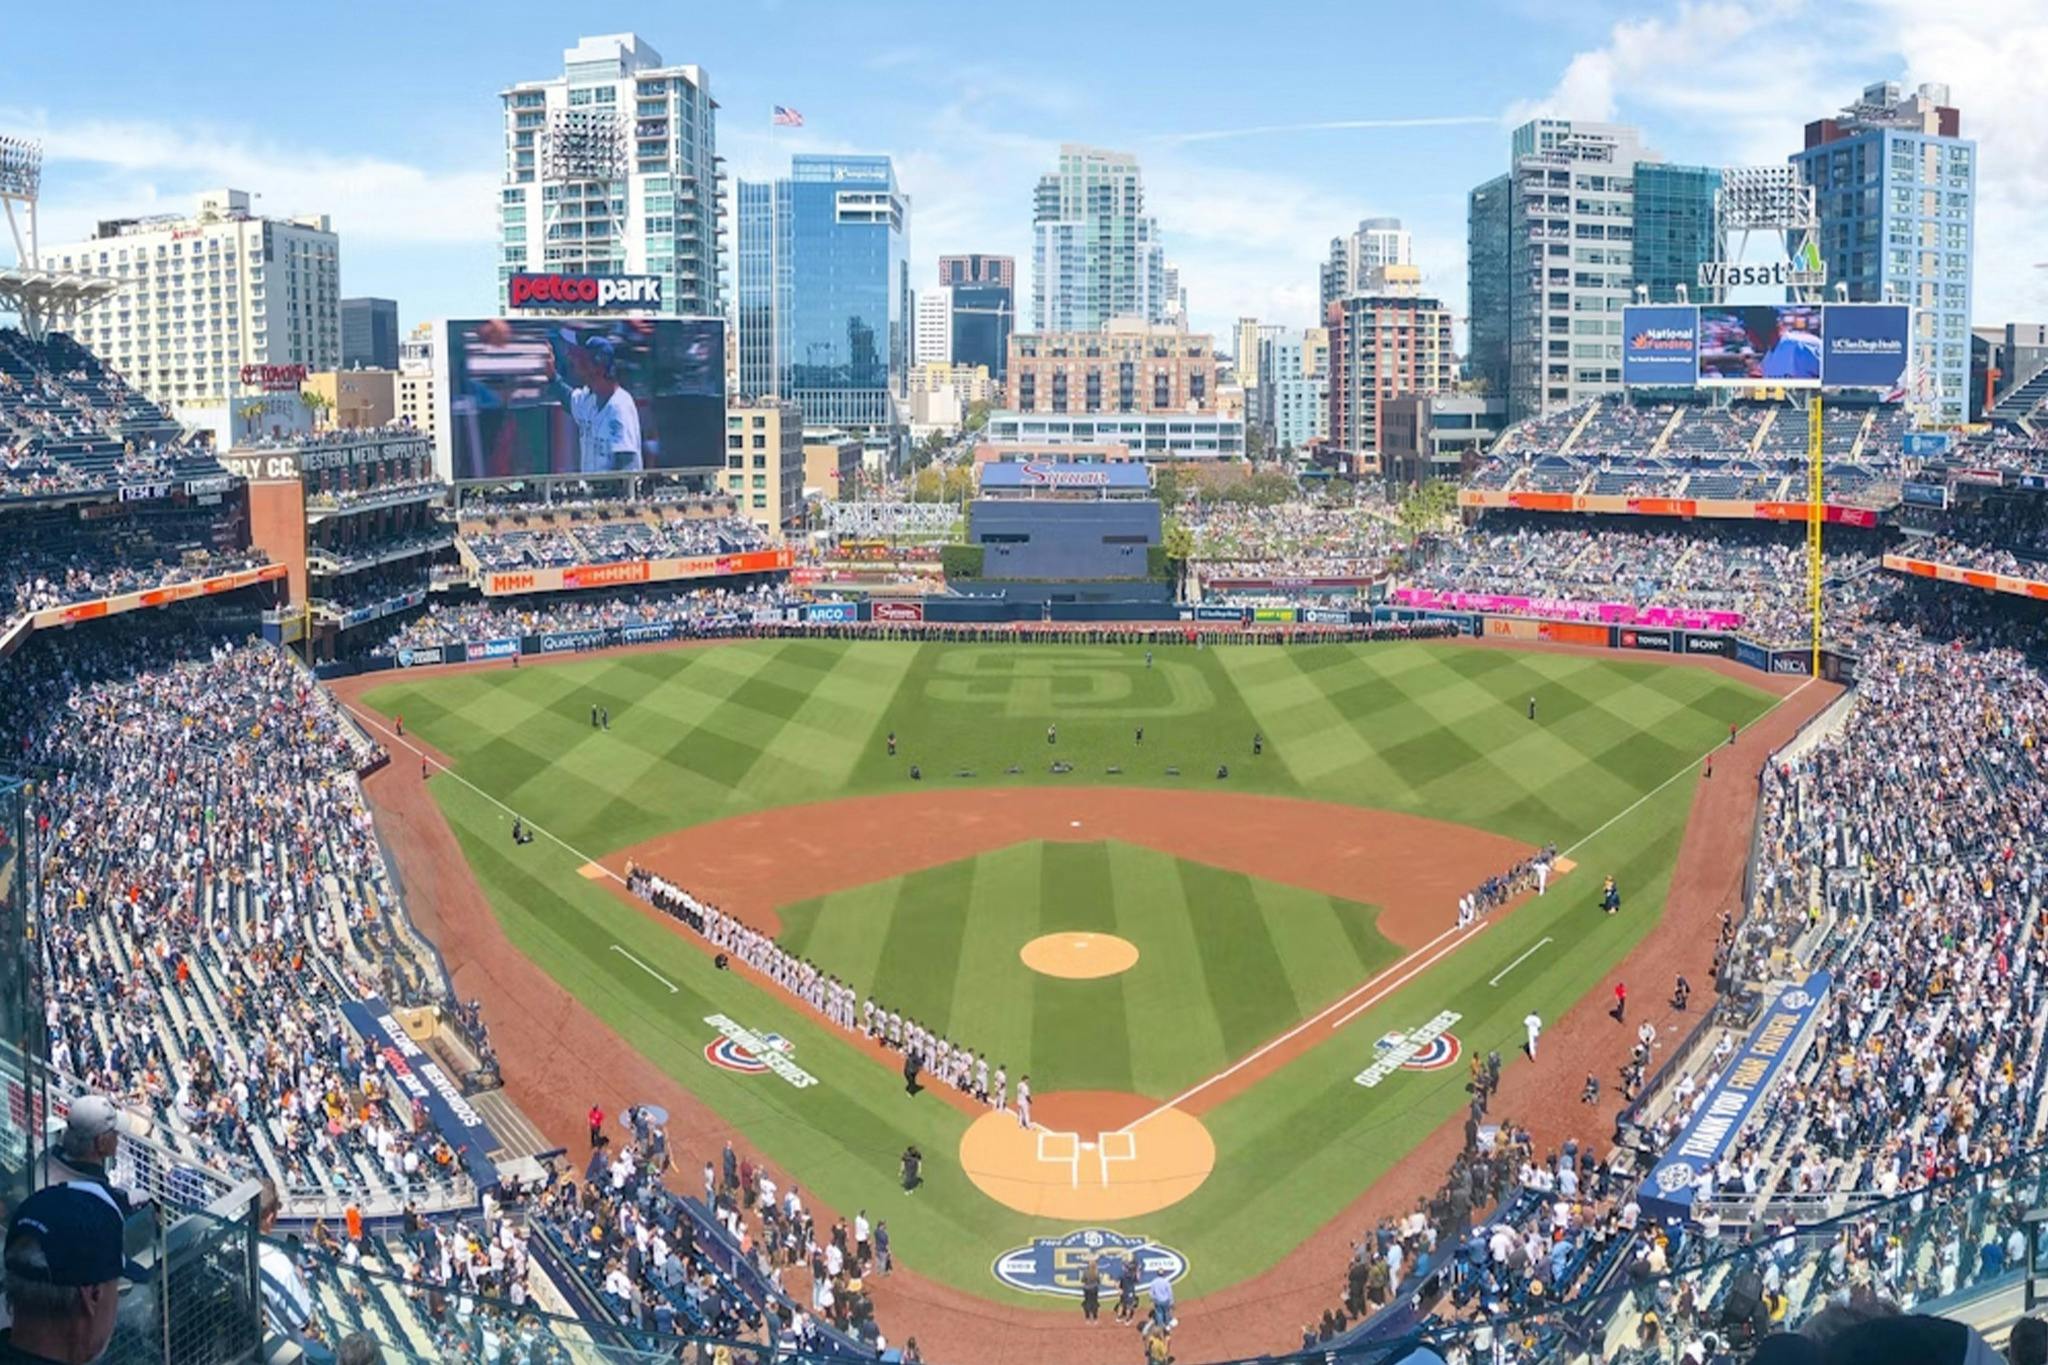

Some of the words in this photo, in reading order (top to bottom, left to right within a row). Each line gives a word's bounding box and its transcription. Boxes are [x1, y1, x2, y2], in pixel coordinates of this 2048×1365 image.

[1702, 262, 1785, 285] Viasat
[1647, 328, 1693, 339] National
[1647, 339, 1692, 350] Funding
[261, 364, 309, 382] TOYOTA
[302, 450, 349, 471] WESTERN
[352, 446, 380, 463] METAL
[382, 443, 413, 460] SUPPLY
[493, 575, 533, 591] MMM
[810, 609, 843, 619] ARCO
[1494, 621, 1511, 634] RA
[1638, 635, 1668, 645] TOYOTA
[1774, 658, 1807, 672] NECA
[377, 1015, 422, 1057] WELCOME
[1749, 1012, 1802, 1057] FAITHFUL
[703, 1013, 769, 1054] OPENING
[756, 1051, 819, 1088] SERIES
[1353, 1041, 1421, 1087] OPENING
[1409, 1010, 1463, 1045] SERIES
[1727, 1057, 1771, 1090] FRIAR
[1711, 1091, 1748, 1119] YOU
[1678, 1114, 1738, 1158] THANK
